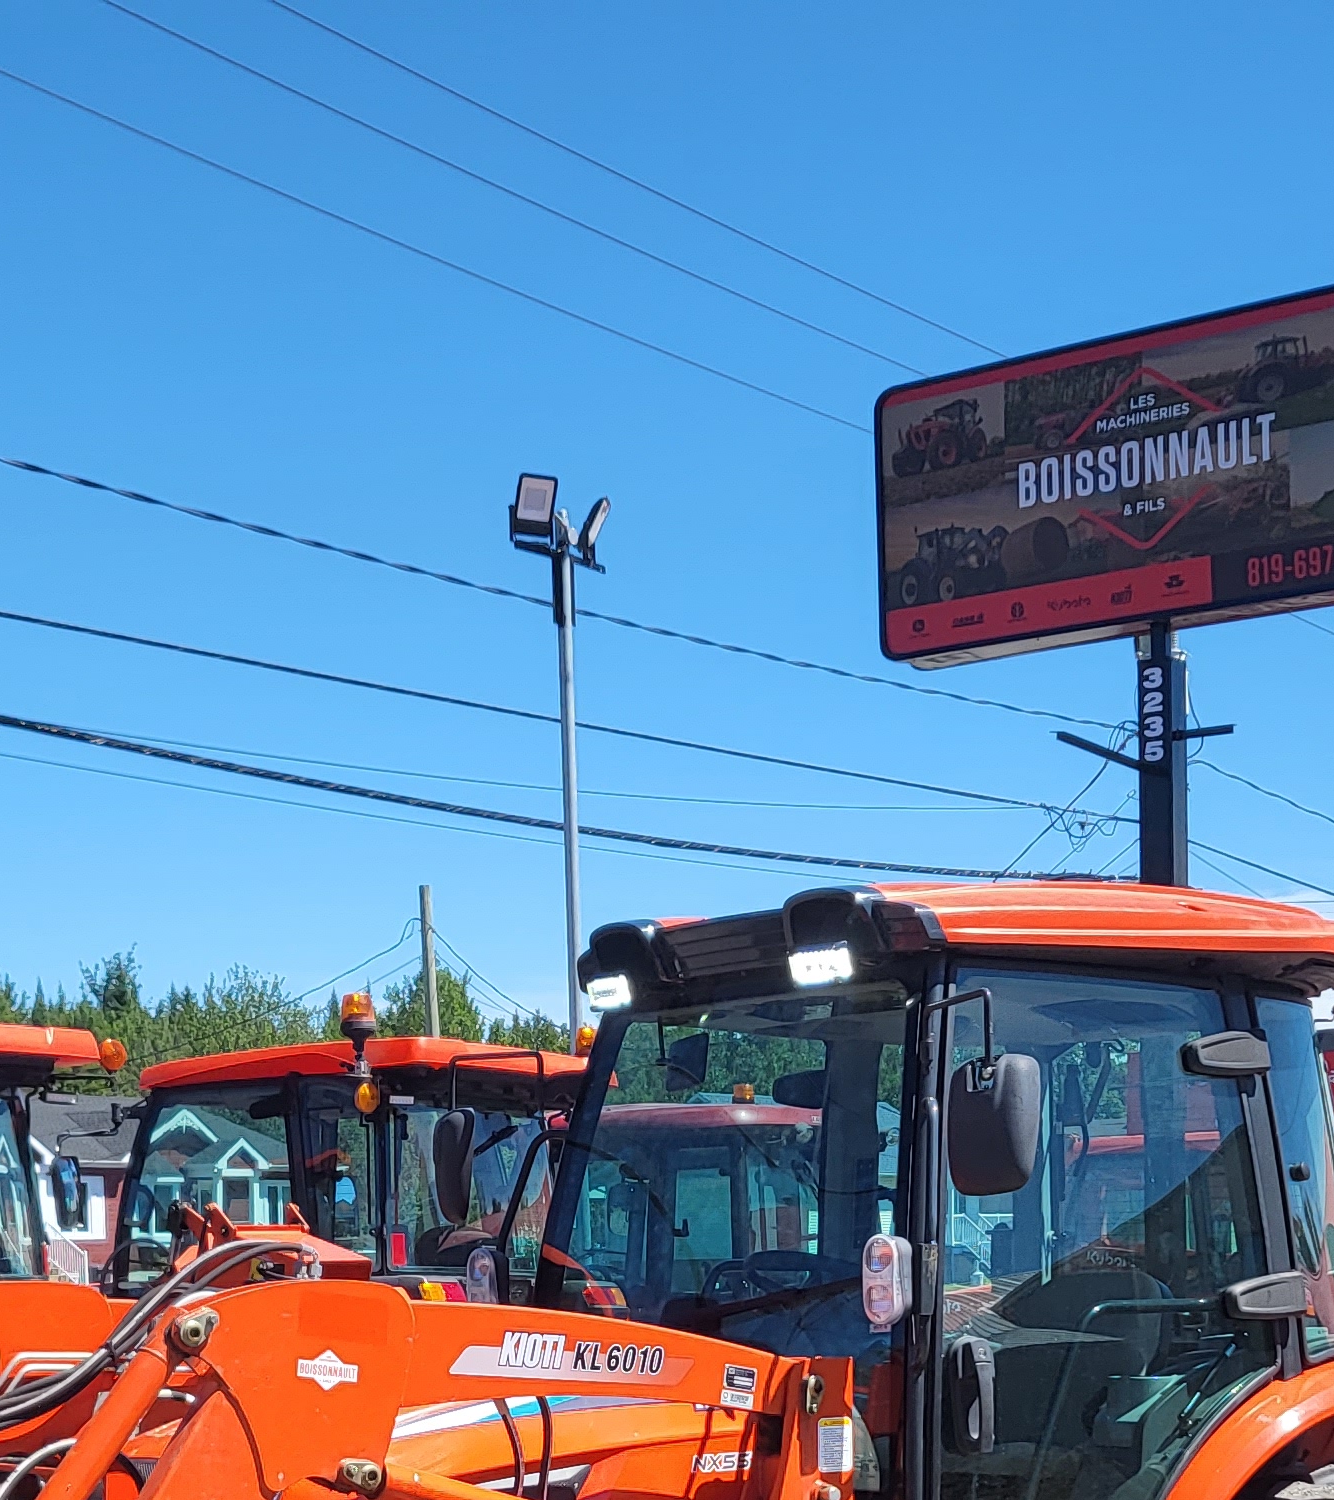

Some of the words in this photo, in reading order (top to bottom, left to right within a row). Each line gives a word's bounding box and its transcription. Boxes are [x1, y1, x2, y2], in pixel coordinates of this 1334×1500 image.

[1130, 393, 1155, 410] LES
[1096, 402, 1190, 433] MACHINERIES
[1017, 412, 1276, 509] BOISSONNAULT
[1123, 502, 1133, 516] &
[1136, 498, 1165, 514] FILS
[1142, 667, 1164, 762] 3235
[498, 1330, 566, 1370] KIOTI
[299, 1362, 357, 1379] BOISSONNAULT
